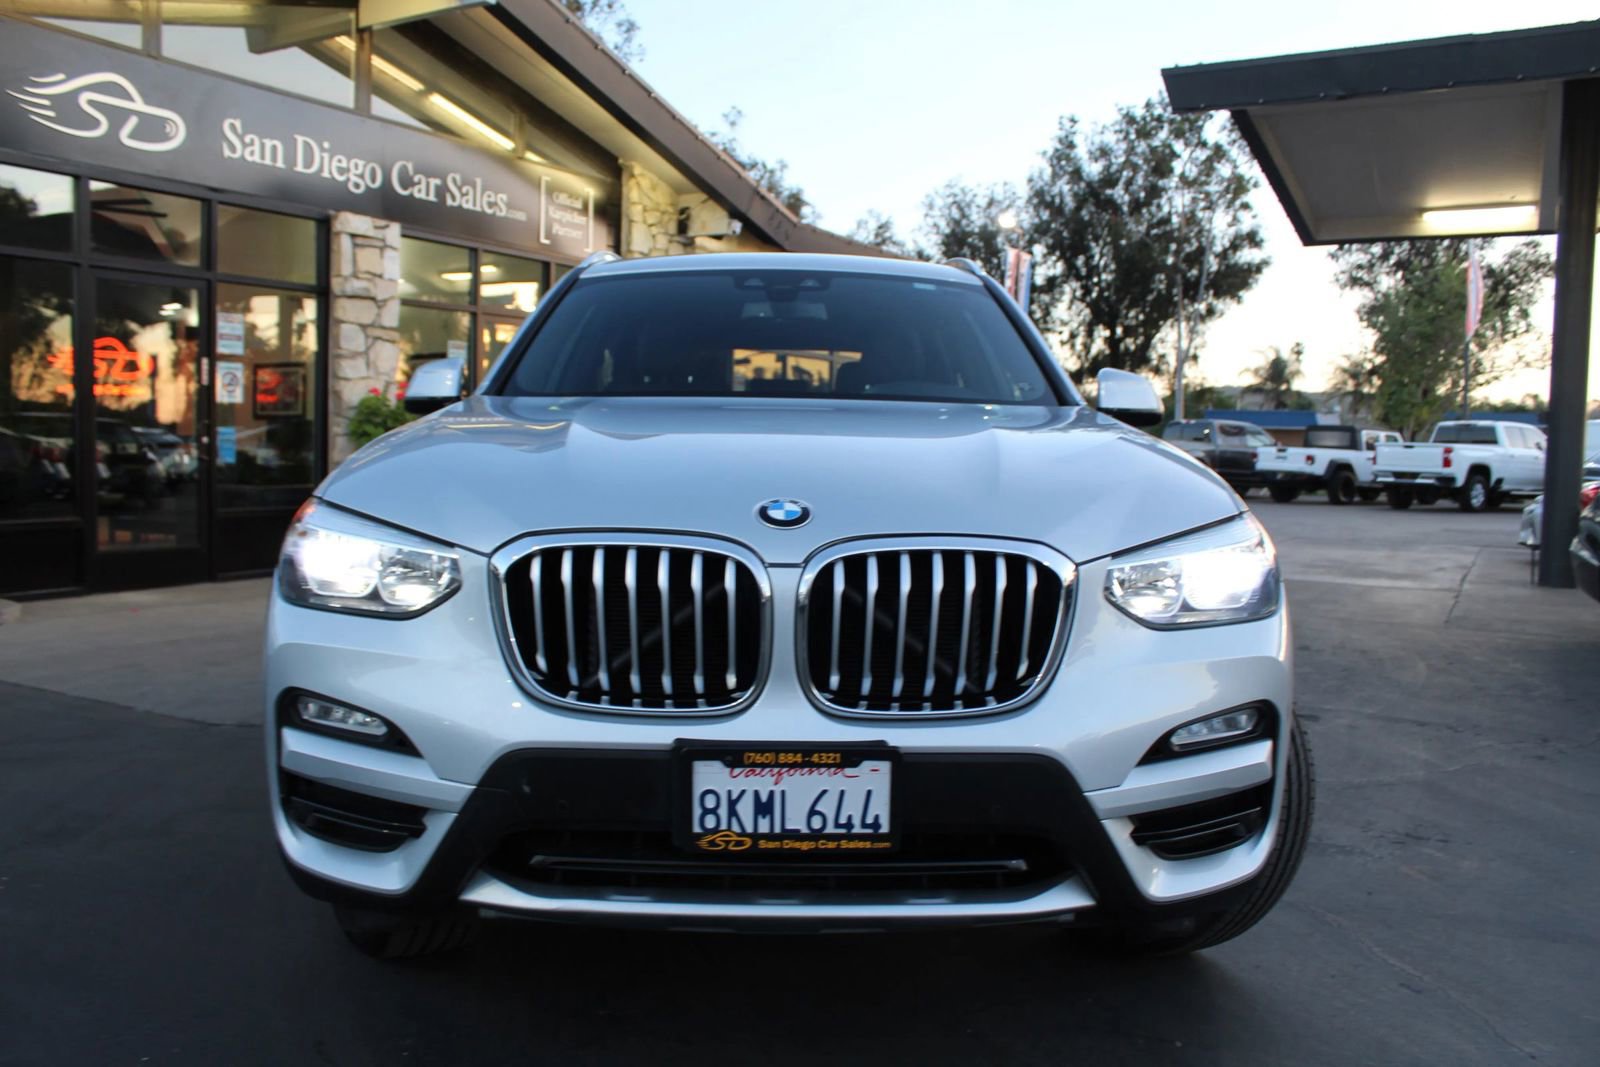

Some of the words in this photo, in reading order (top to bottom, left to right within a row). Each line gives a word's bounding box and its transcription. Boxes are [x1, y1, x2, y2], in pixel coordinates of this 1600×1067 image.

[222, 117, 286, 169] San
[293, 134, 383, 194] Diego
[391, 160, 442, 202] Car
[744, 752, 776, 765] (760)
[698, 788, 882, 834] 8KML644
[758, 839, 781, 849] San
[783, 839, 816, 851] Diego
[817, 839, 838, 849] Car
